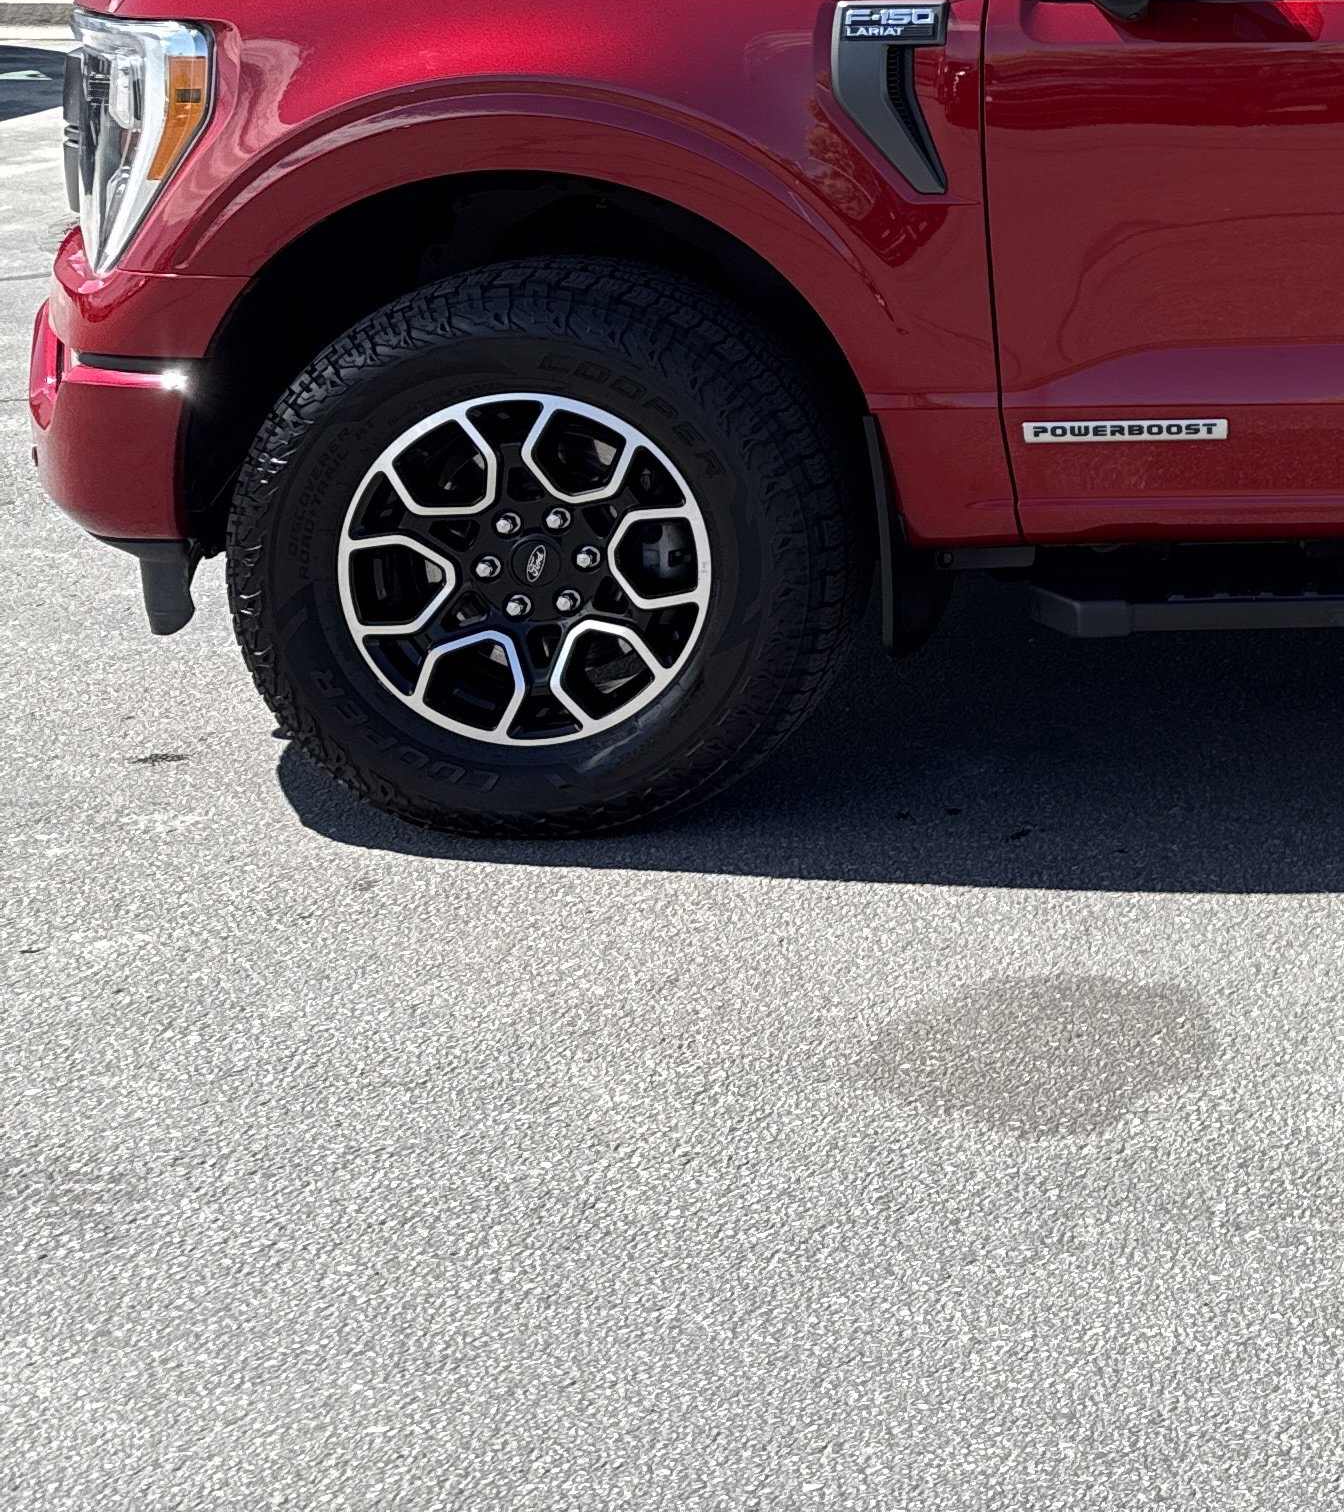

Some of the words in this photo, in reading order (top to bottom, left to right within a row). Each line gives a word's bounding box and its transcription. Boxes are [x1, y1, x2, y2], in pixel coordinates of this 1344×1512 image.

[844, 7, 935, 25] F-150
[845, 25, 905, 36] LARIAT
[540, 351, 726, 480] COOPER
[1032, 422, 1218, 438] POWERBOOST
[528, 546, 545, 580] Ford
[308, 663, 499, 795] COOPER
